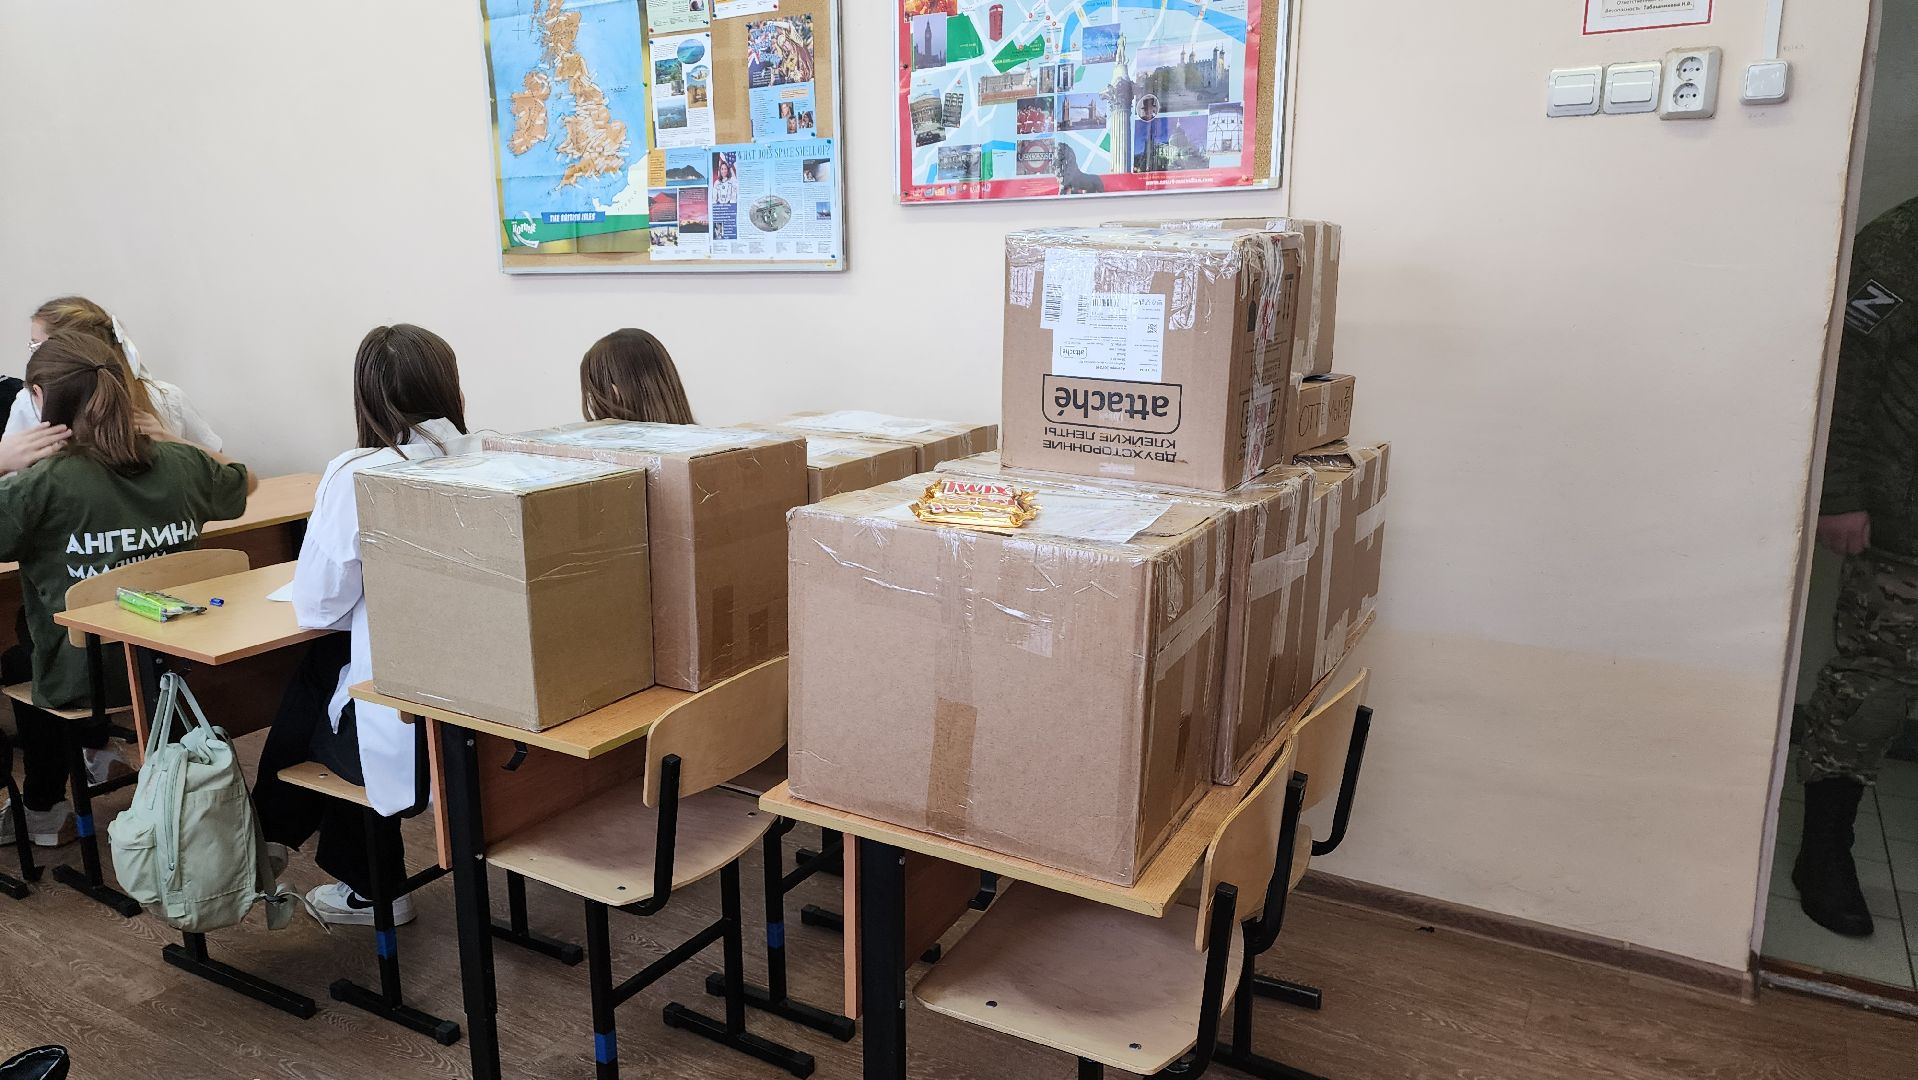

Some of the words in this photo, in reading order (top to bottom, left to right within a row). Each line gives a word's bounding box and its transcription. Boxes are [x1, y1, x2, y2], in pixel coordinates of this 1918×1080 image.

[737, 150, 755, 161] WHAT
[1054, 386, 1170, 421] attaché
[1044, 426, 1095, 441] ЛЕНТЫ
[1099, 432, 1177, 449] КЛЕЙКИЕ
[1042, 439, 1177, 463] ДВУХСТОРОННИЕ
[65, 518, 199, 555] АНГЕЛИНА
